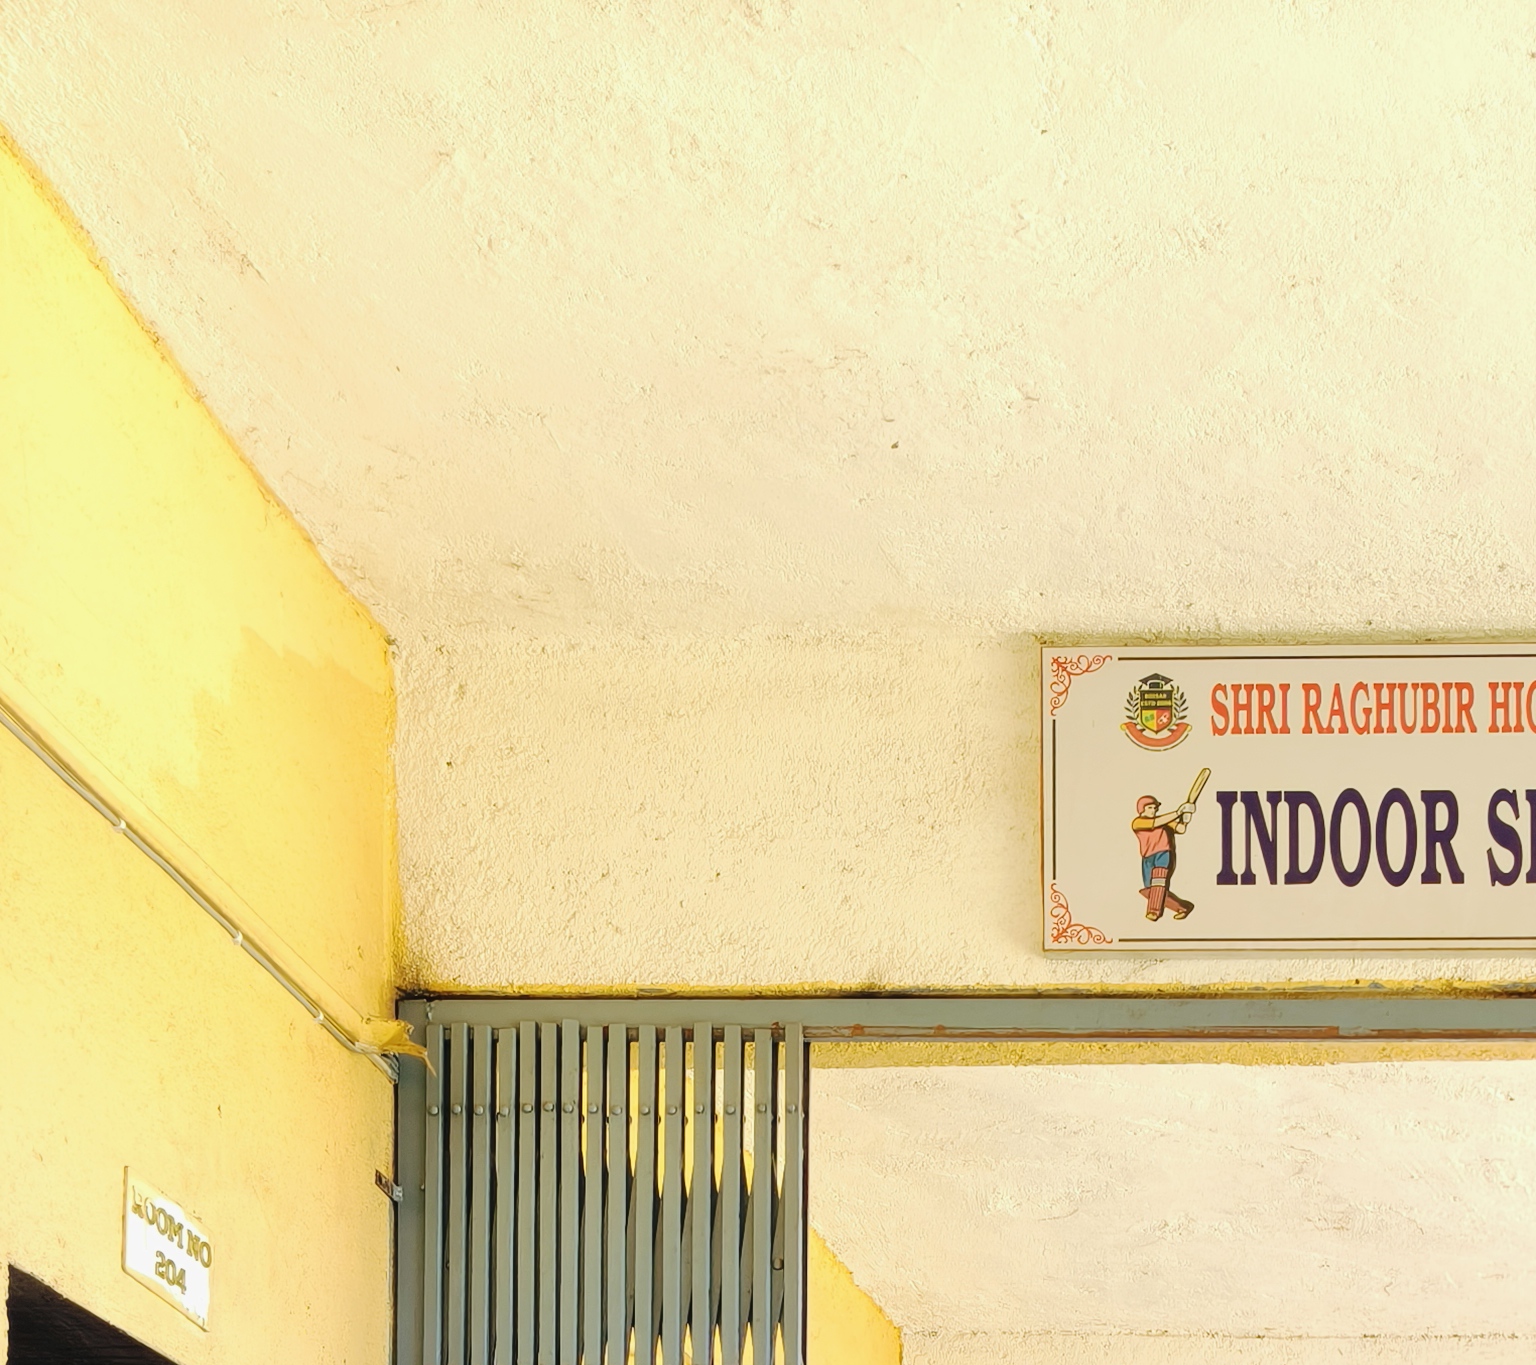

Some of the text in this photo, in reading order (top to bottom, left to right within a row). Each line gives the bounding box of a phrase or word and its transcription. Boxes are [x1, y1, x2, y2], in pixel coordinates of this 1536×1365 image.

[1211, 682, 1291, 736] SHRI
[1301, 681, 1477, 735] RAGHUBIR
[1216, 787, 1465, 887] INDOOR
[155, 1250, 187, 1296] 204
[186, 1228, 213, 1269] NO
